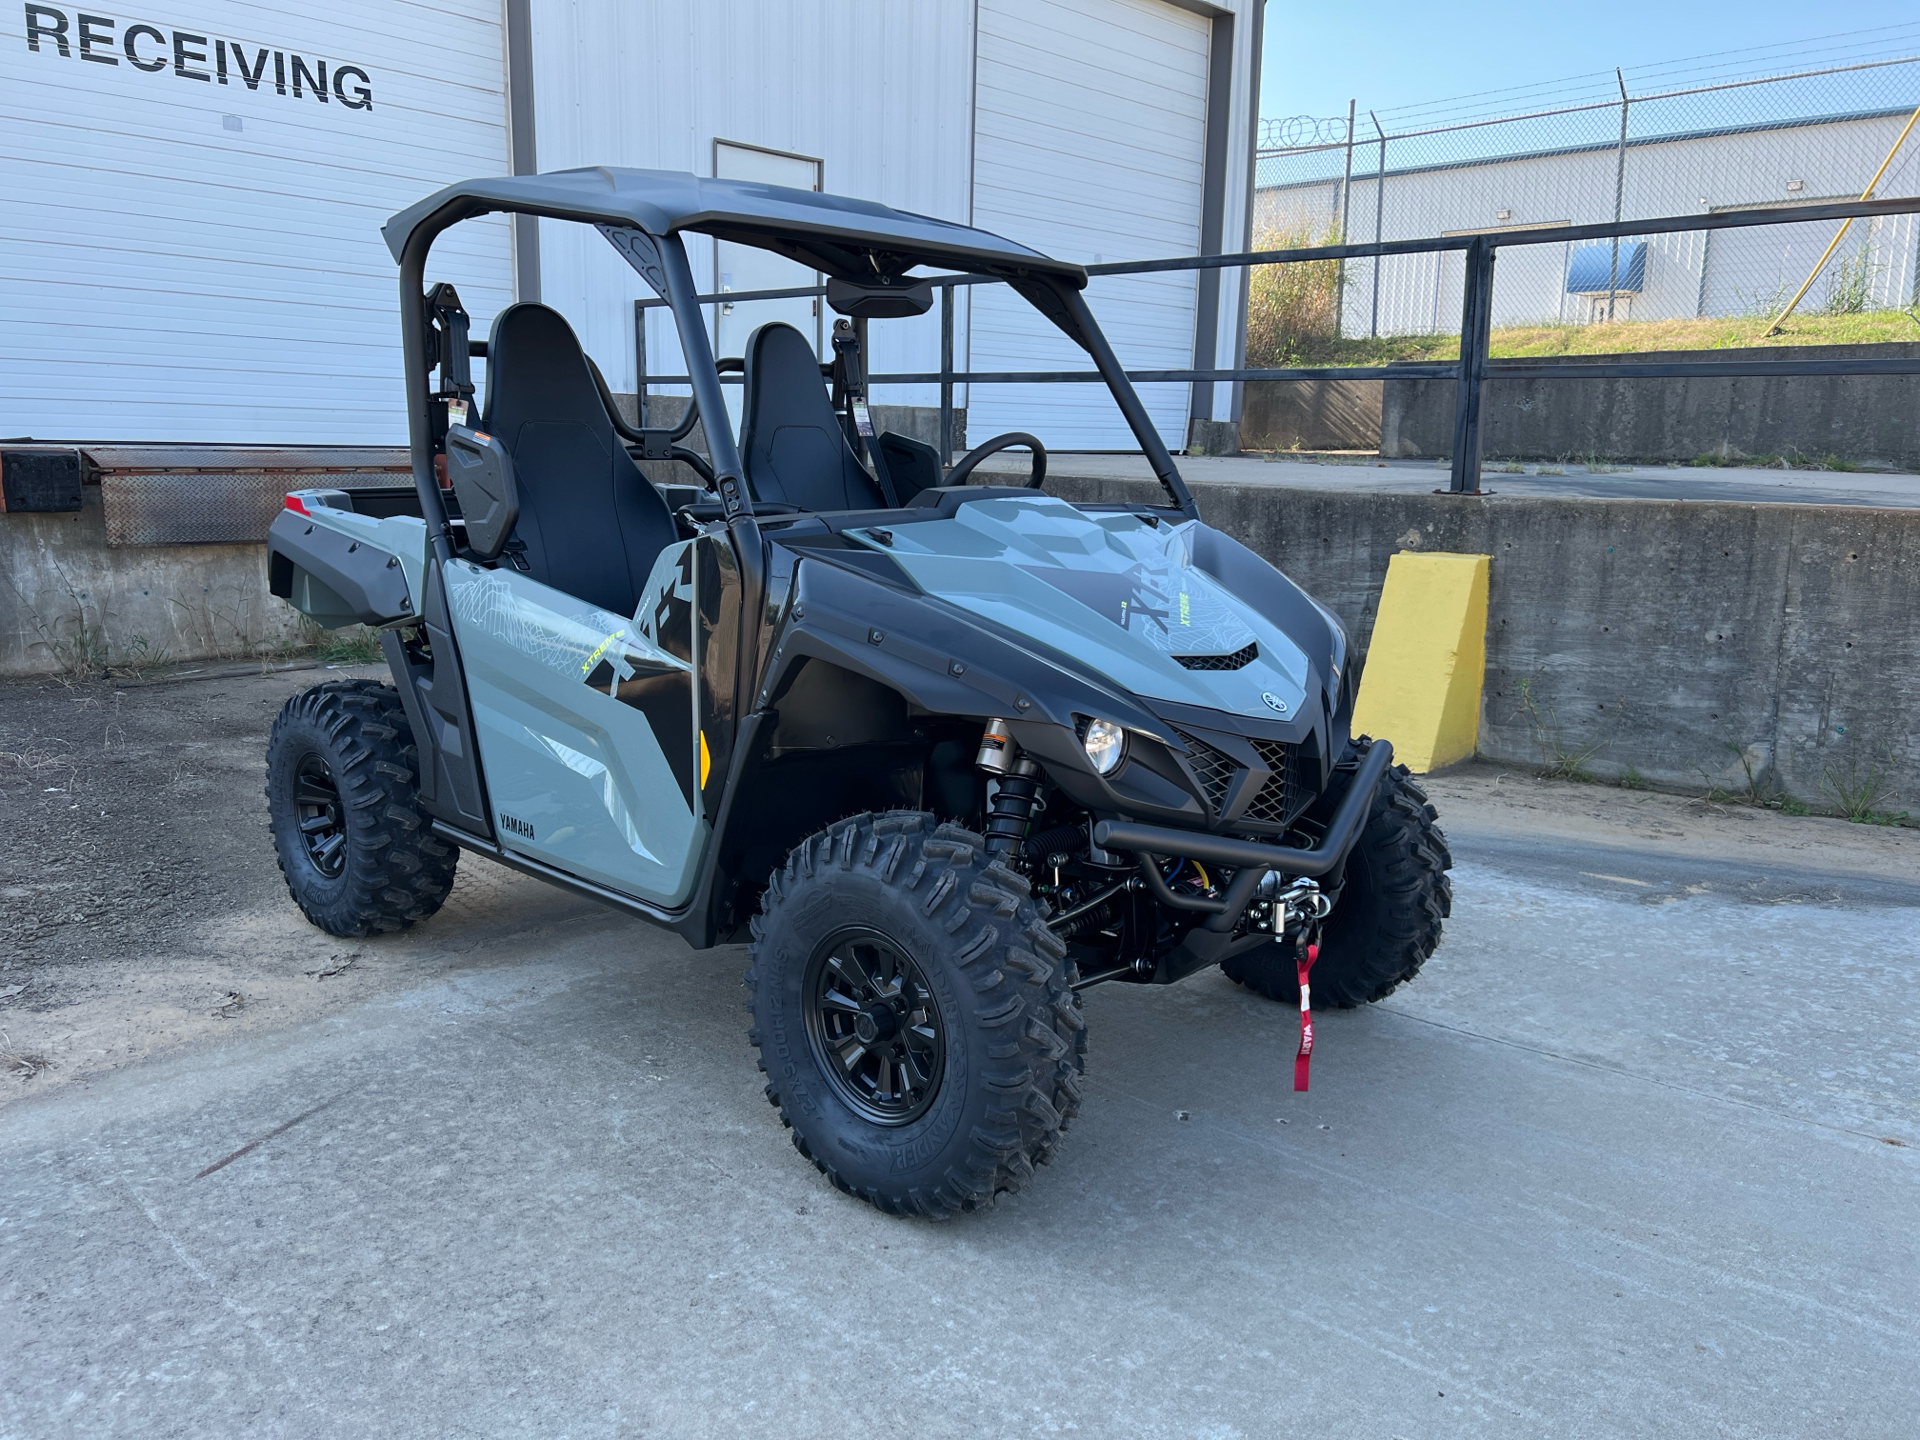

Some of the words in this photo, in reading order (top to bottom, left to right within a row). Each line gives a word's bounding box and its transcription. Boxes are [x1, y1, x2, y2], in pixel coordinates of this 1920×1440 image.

[24, 2, 373, 111] RECEIVING
[1179, 592, 1190, 627] XTREME
[582, 629, 625, 675] XTREME
[500, 813, 535, 840] YAMAHA
[769, 945, 790, 992] NHS
